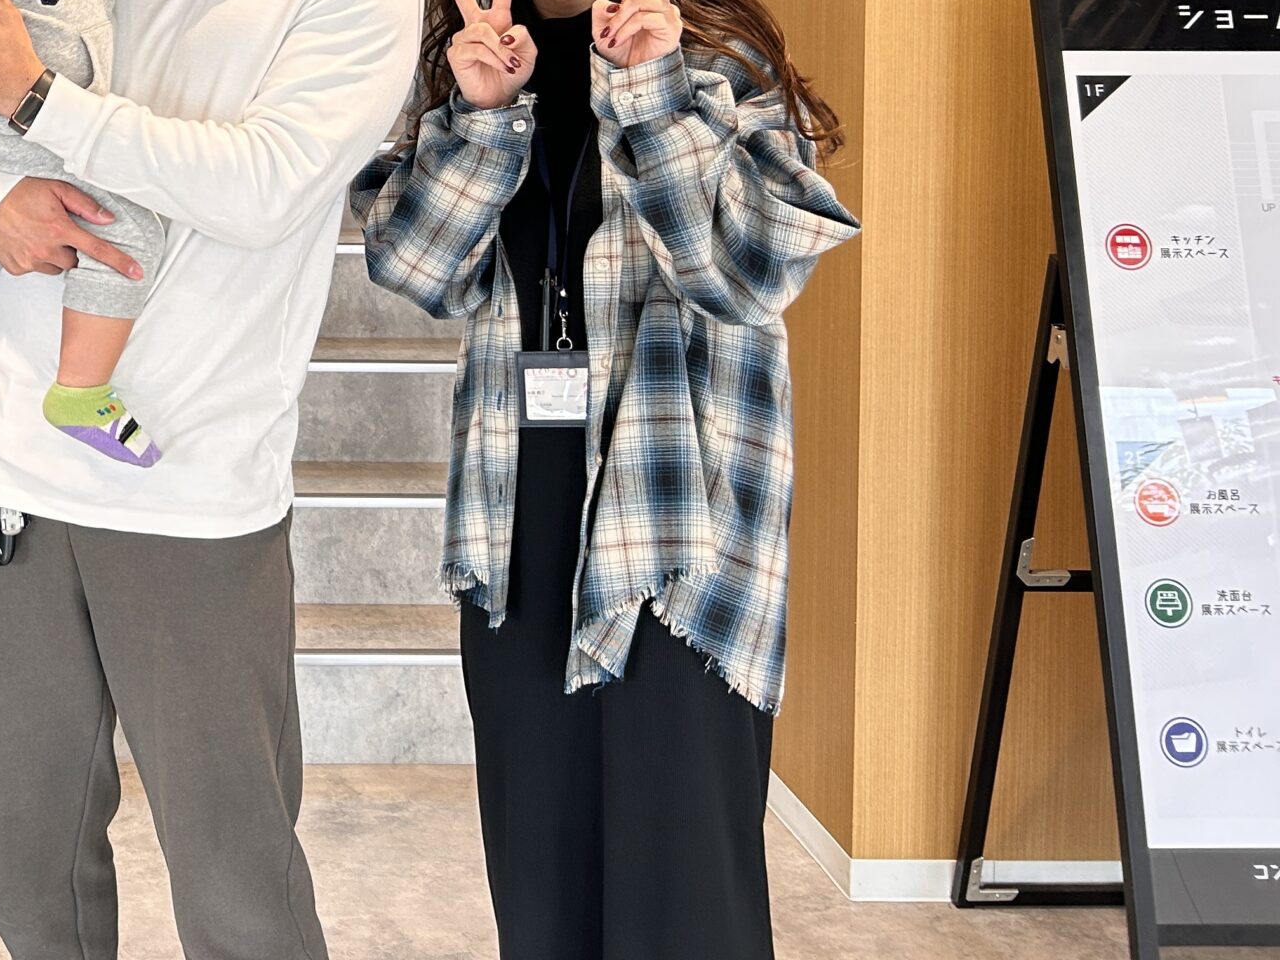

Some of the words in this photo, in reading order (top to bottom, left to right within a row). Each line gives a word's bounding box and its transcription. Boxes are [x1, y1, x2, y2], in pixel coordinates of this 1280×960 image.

[1177, 5, 1280, 29] ショー
[1084, 83, 1105, 98] 1F
[1261, 202, 1276, 213] UP
[1170, 235, 1215, 245] キッチン
[1160, 247, 1229, 259] 展示スペース
[1124, 451, 1146, 465] 2F
[1206, 489, 1241, 501] お風呂
[1189, 503, 1260, 516] 展示スペース
[1216, 589, 1253, 602] 洗面台
[1201, 603, 1272, 617] 展示スペース
[1235, 726, 1268, 739] トイレ
